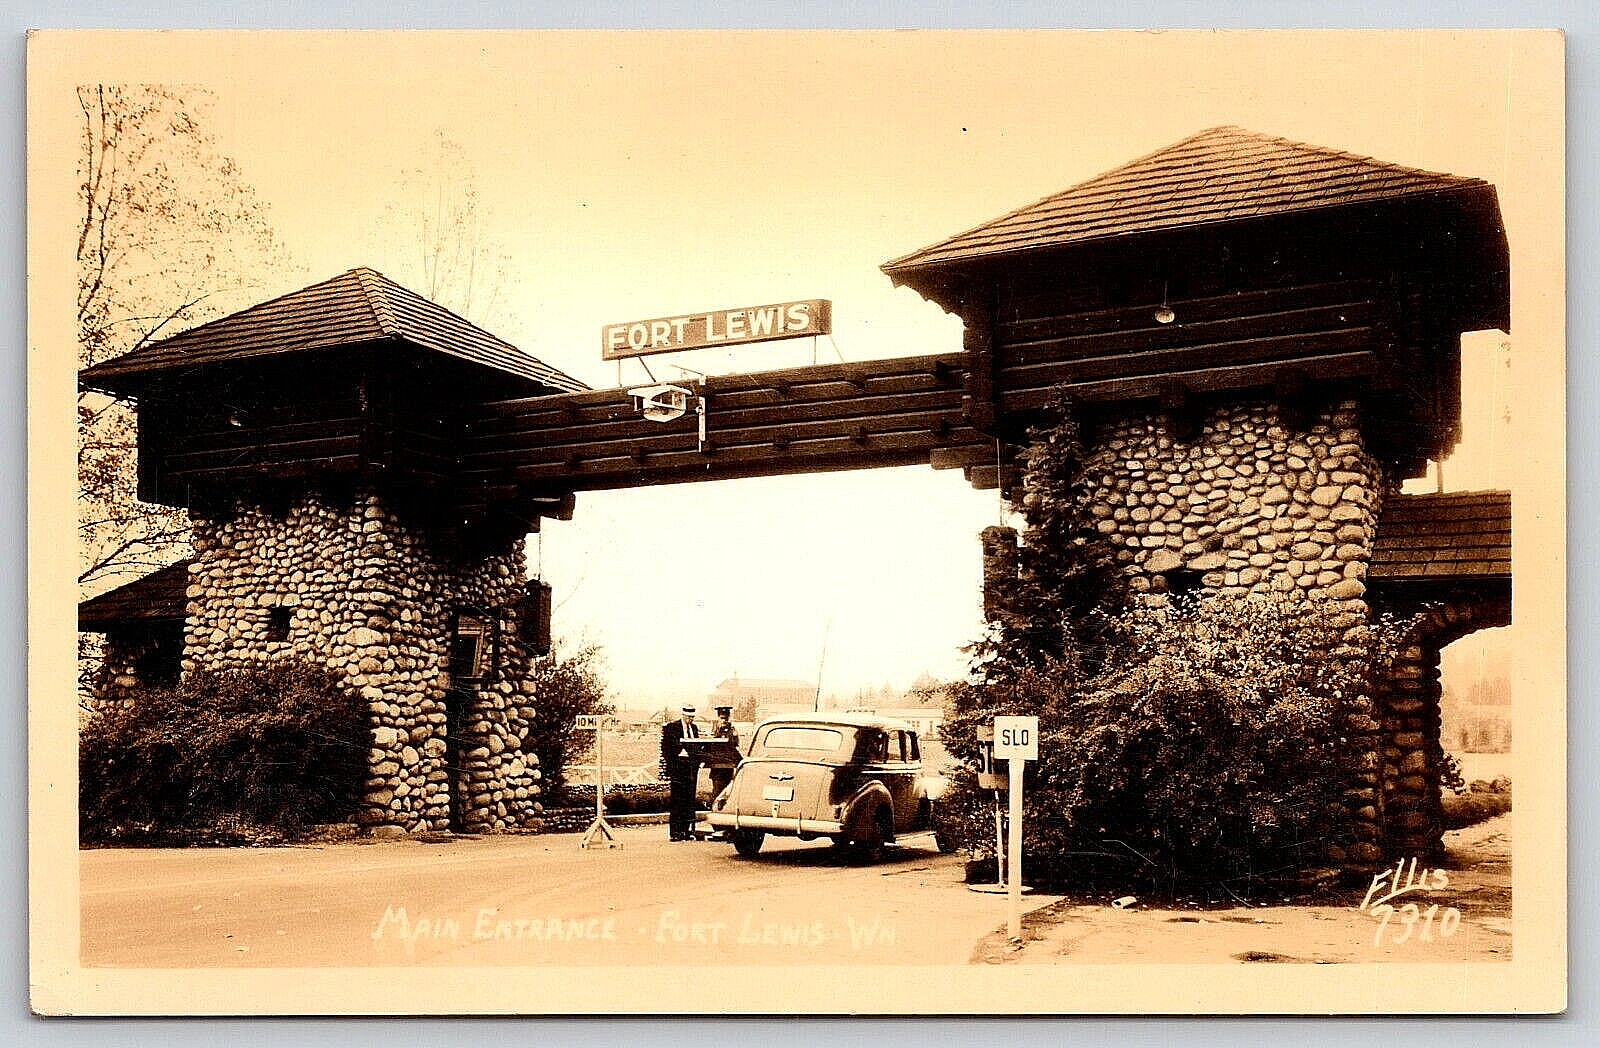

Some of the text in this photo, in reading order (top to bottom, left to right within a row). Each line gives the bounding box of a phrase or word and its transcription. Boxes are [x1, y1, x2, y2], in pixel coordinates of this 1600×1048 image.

[607, 303, 811, 354] FORT LEWIS
[1002, 728, 1029, 747] SLO
